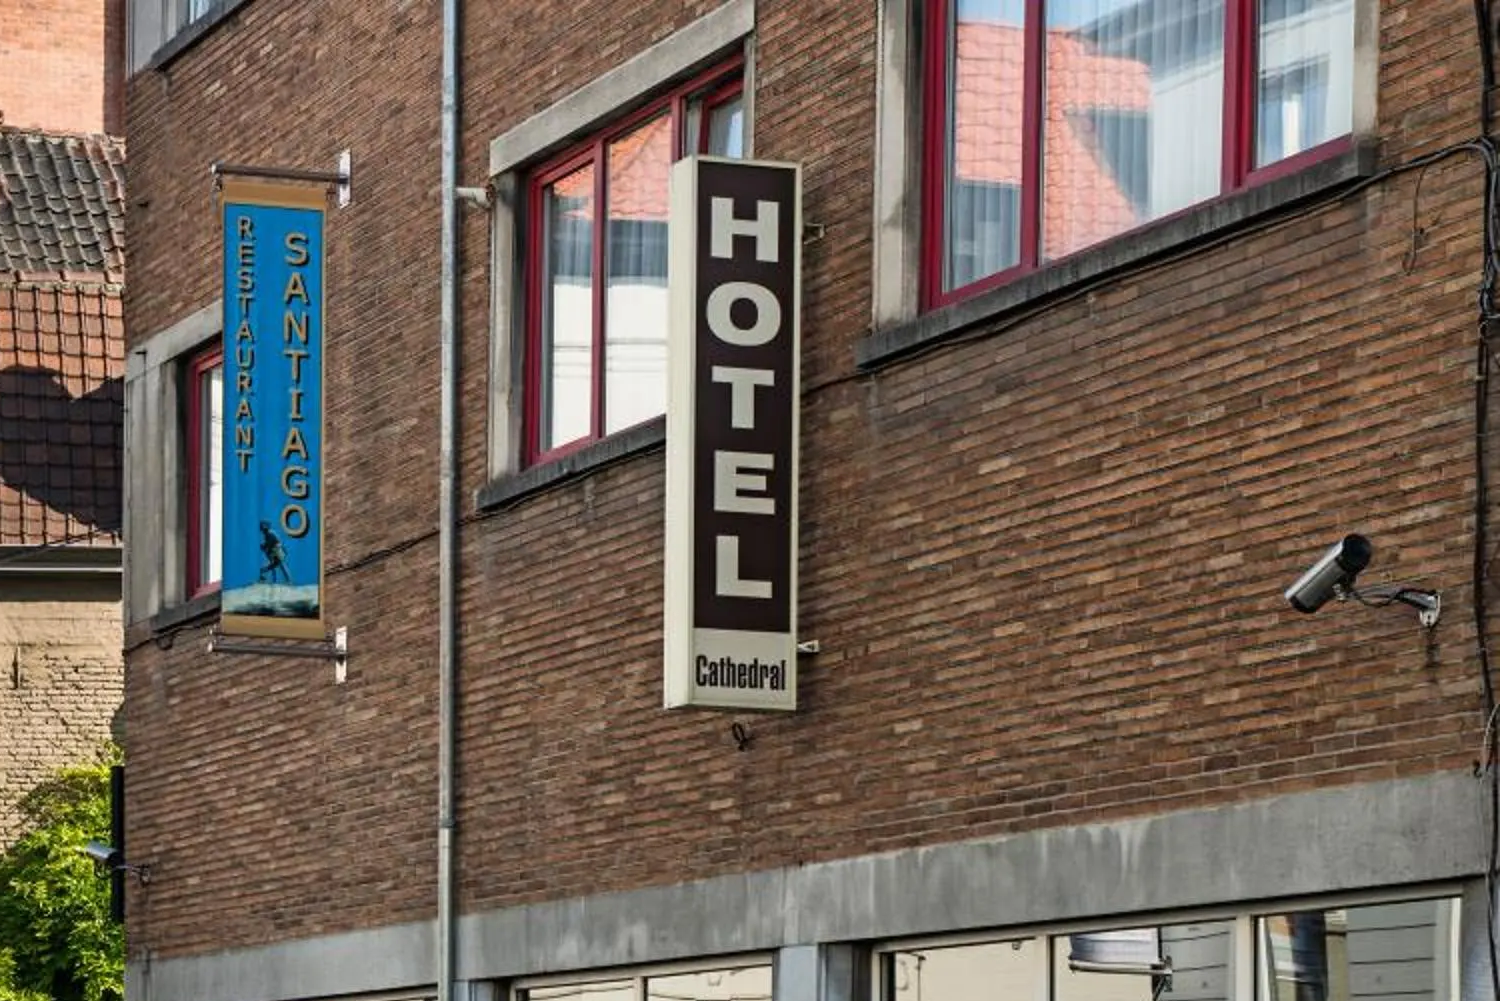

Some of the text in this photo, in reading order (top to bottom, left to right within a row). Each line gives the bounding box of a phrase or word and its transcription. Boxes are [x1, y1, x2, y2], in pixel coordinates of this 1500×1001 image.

[235, 215, 255, 474] RESTAURANT
[280, 231, 310, 539] SANTIAGO
[705, 195, 782, 600] HOTEL
[695, 653, 787, 691] Cathedral
